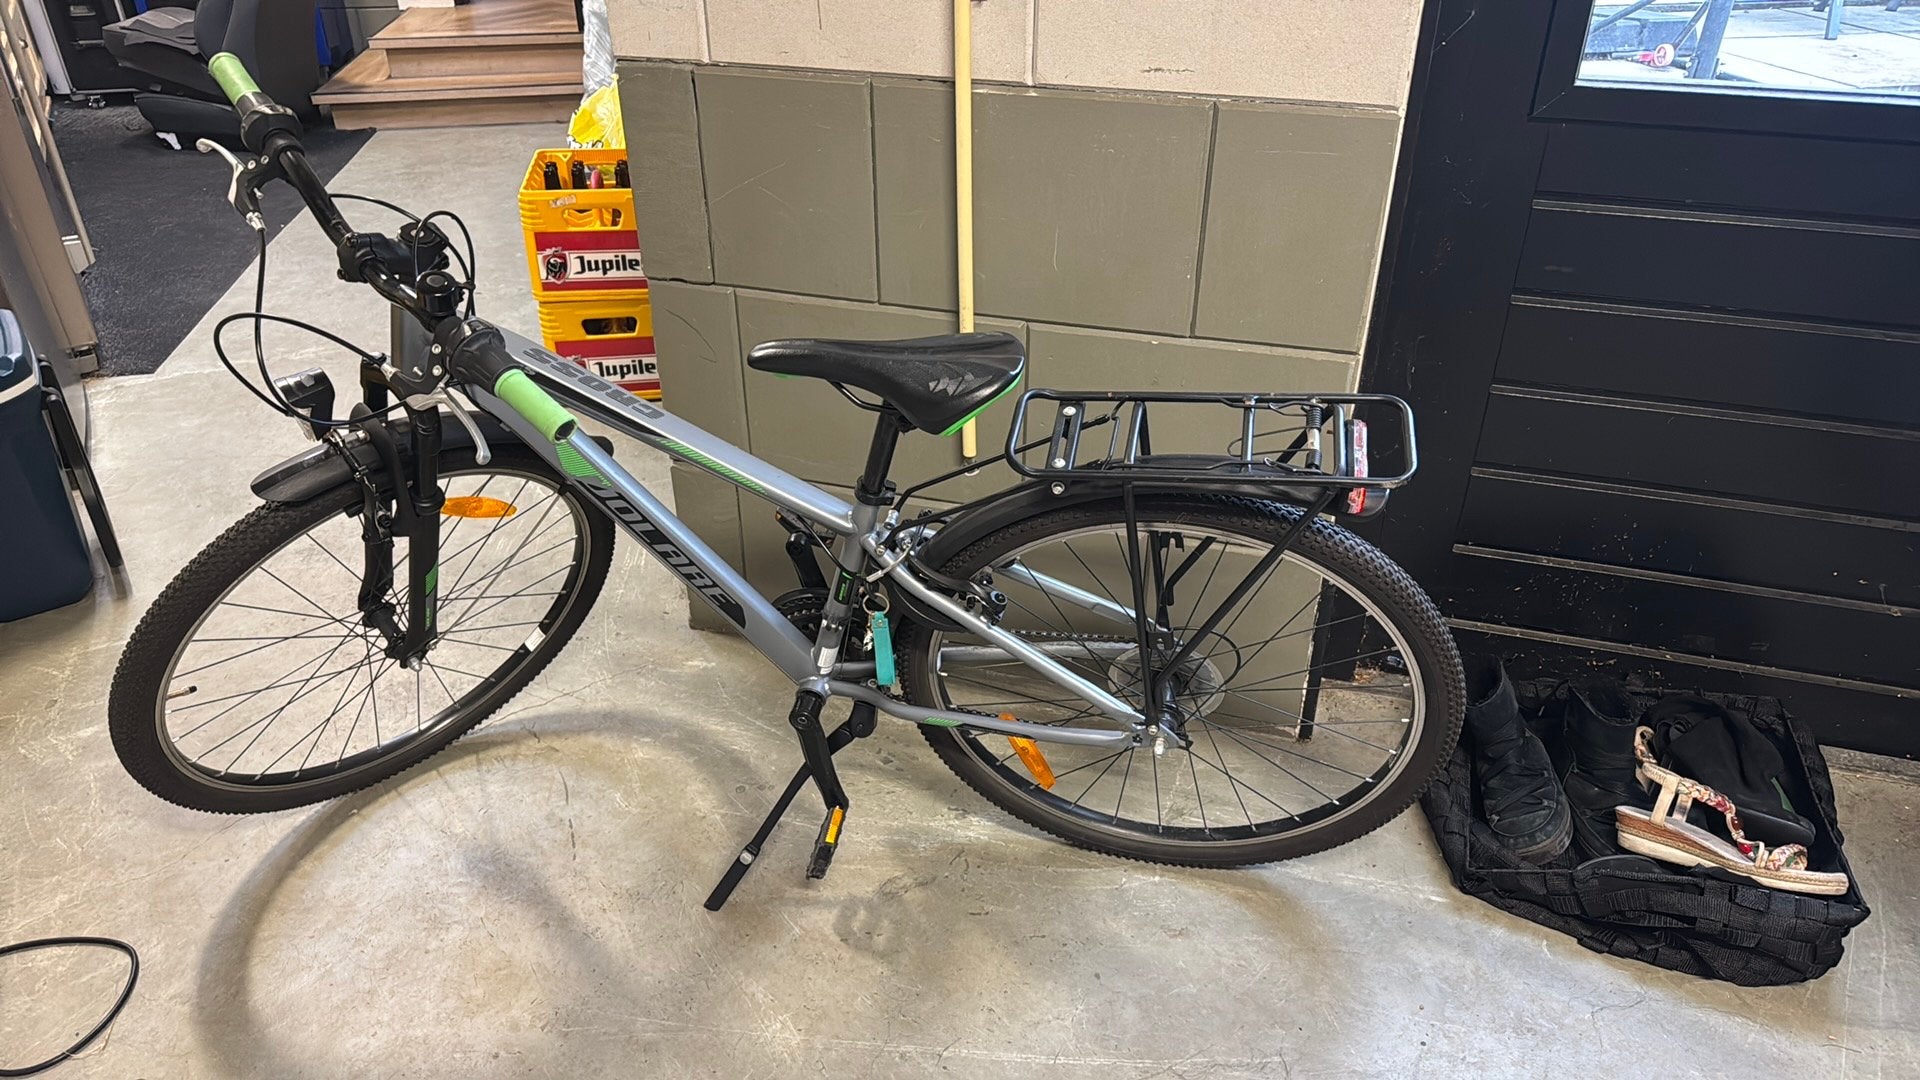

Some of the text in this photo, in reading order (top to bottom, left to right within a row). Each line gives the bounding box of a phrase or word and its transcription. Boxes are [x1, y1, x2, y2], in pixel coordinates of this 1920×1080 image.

[573, 254, 640, 276] Jupile
[592, 359, 657, 380] Jupile
[522, 347, 665, 421] CROSS
